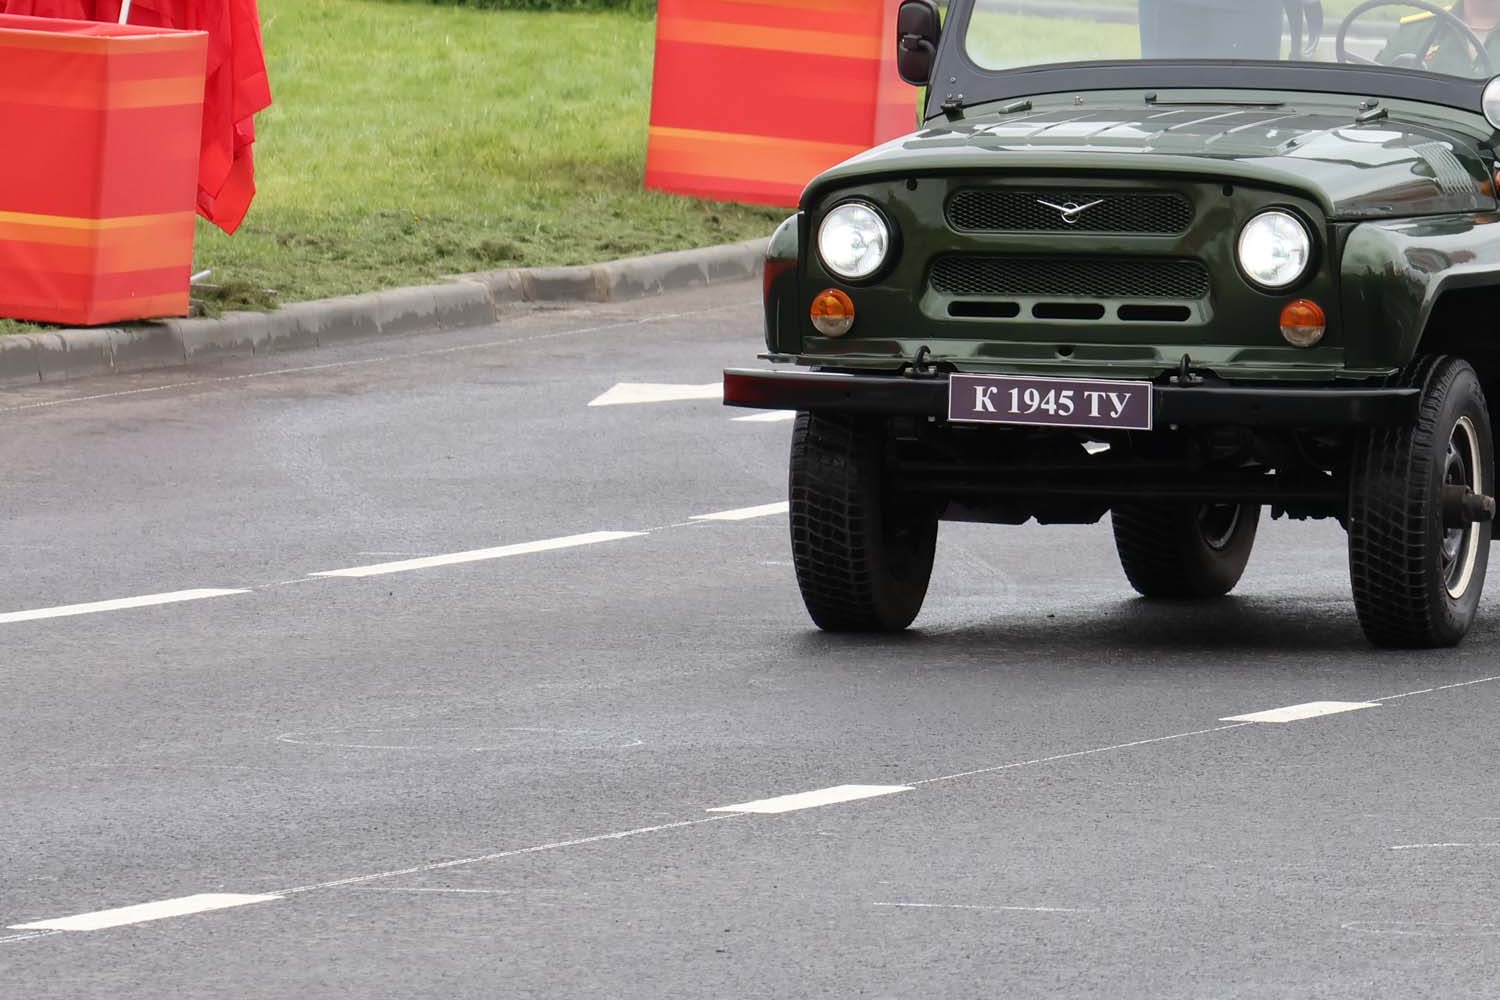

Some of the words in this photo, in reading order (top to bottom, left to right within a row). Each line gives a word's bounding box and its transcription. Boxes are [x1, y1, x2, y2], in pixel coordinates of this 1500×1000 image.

[972, 385, 998, 413] К
[1008, 387, 1075, 417] 1945
[1083, 390, 1132, 419] ТУ
